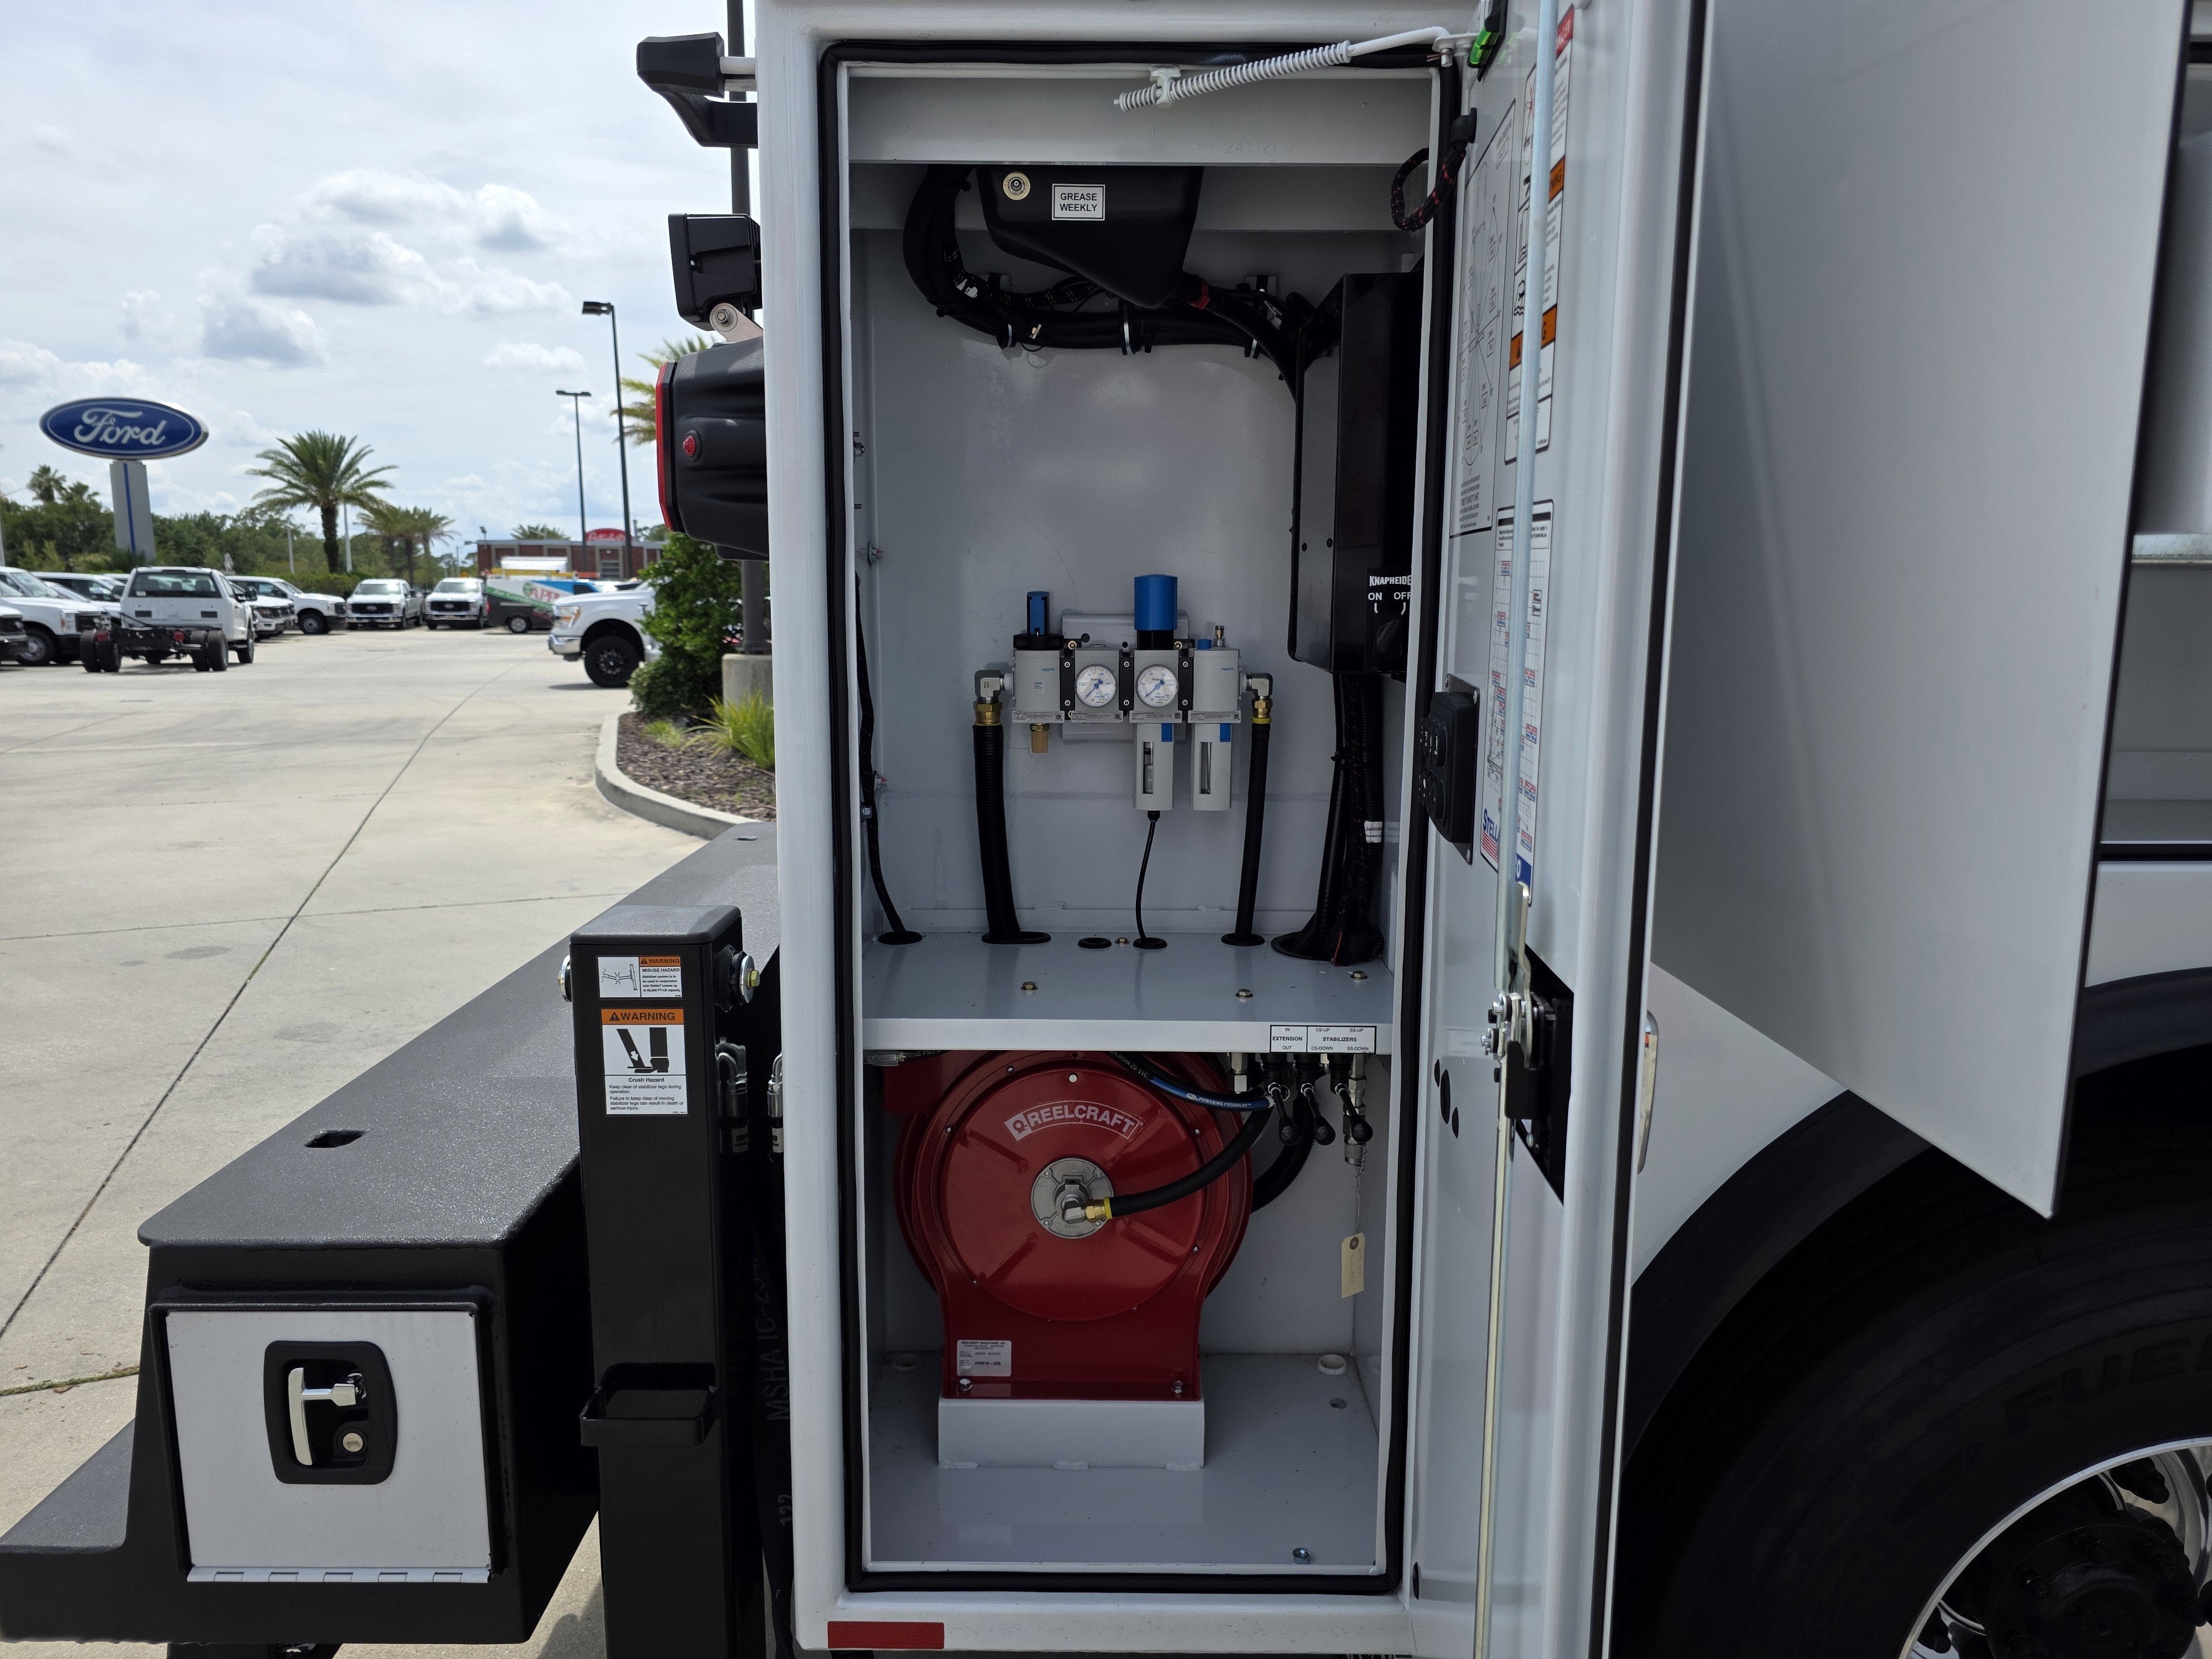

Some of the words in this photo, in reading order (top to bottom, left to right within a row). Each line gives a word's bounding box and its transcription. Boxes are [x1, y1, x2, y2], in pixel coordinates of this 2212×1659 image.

[1060, 192, 1097, 201] GREASE
[1060, 203, 1098, 212] WEEKLY
[74, 408, 167, 446] Ford
[1368, 592, 1383, 601] ON
[620, 1012, 675, 1021] WARNING
[1118, 1053, 1131, 1066] MSHA
[1198, 1097, 1223, 1106] POWERING
[1026, 1104, 1136, 1134] REELCRAFT
[760, 1348, 790, 1422] MSHA
